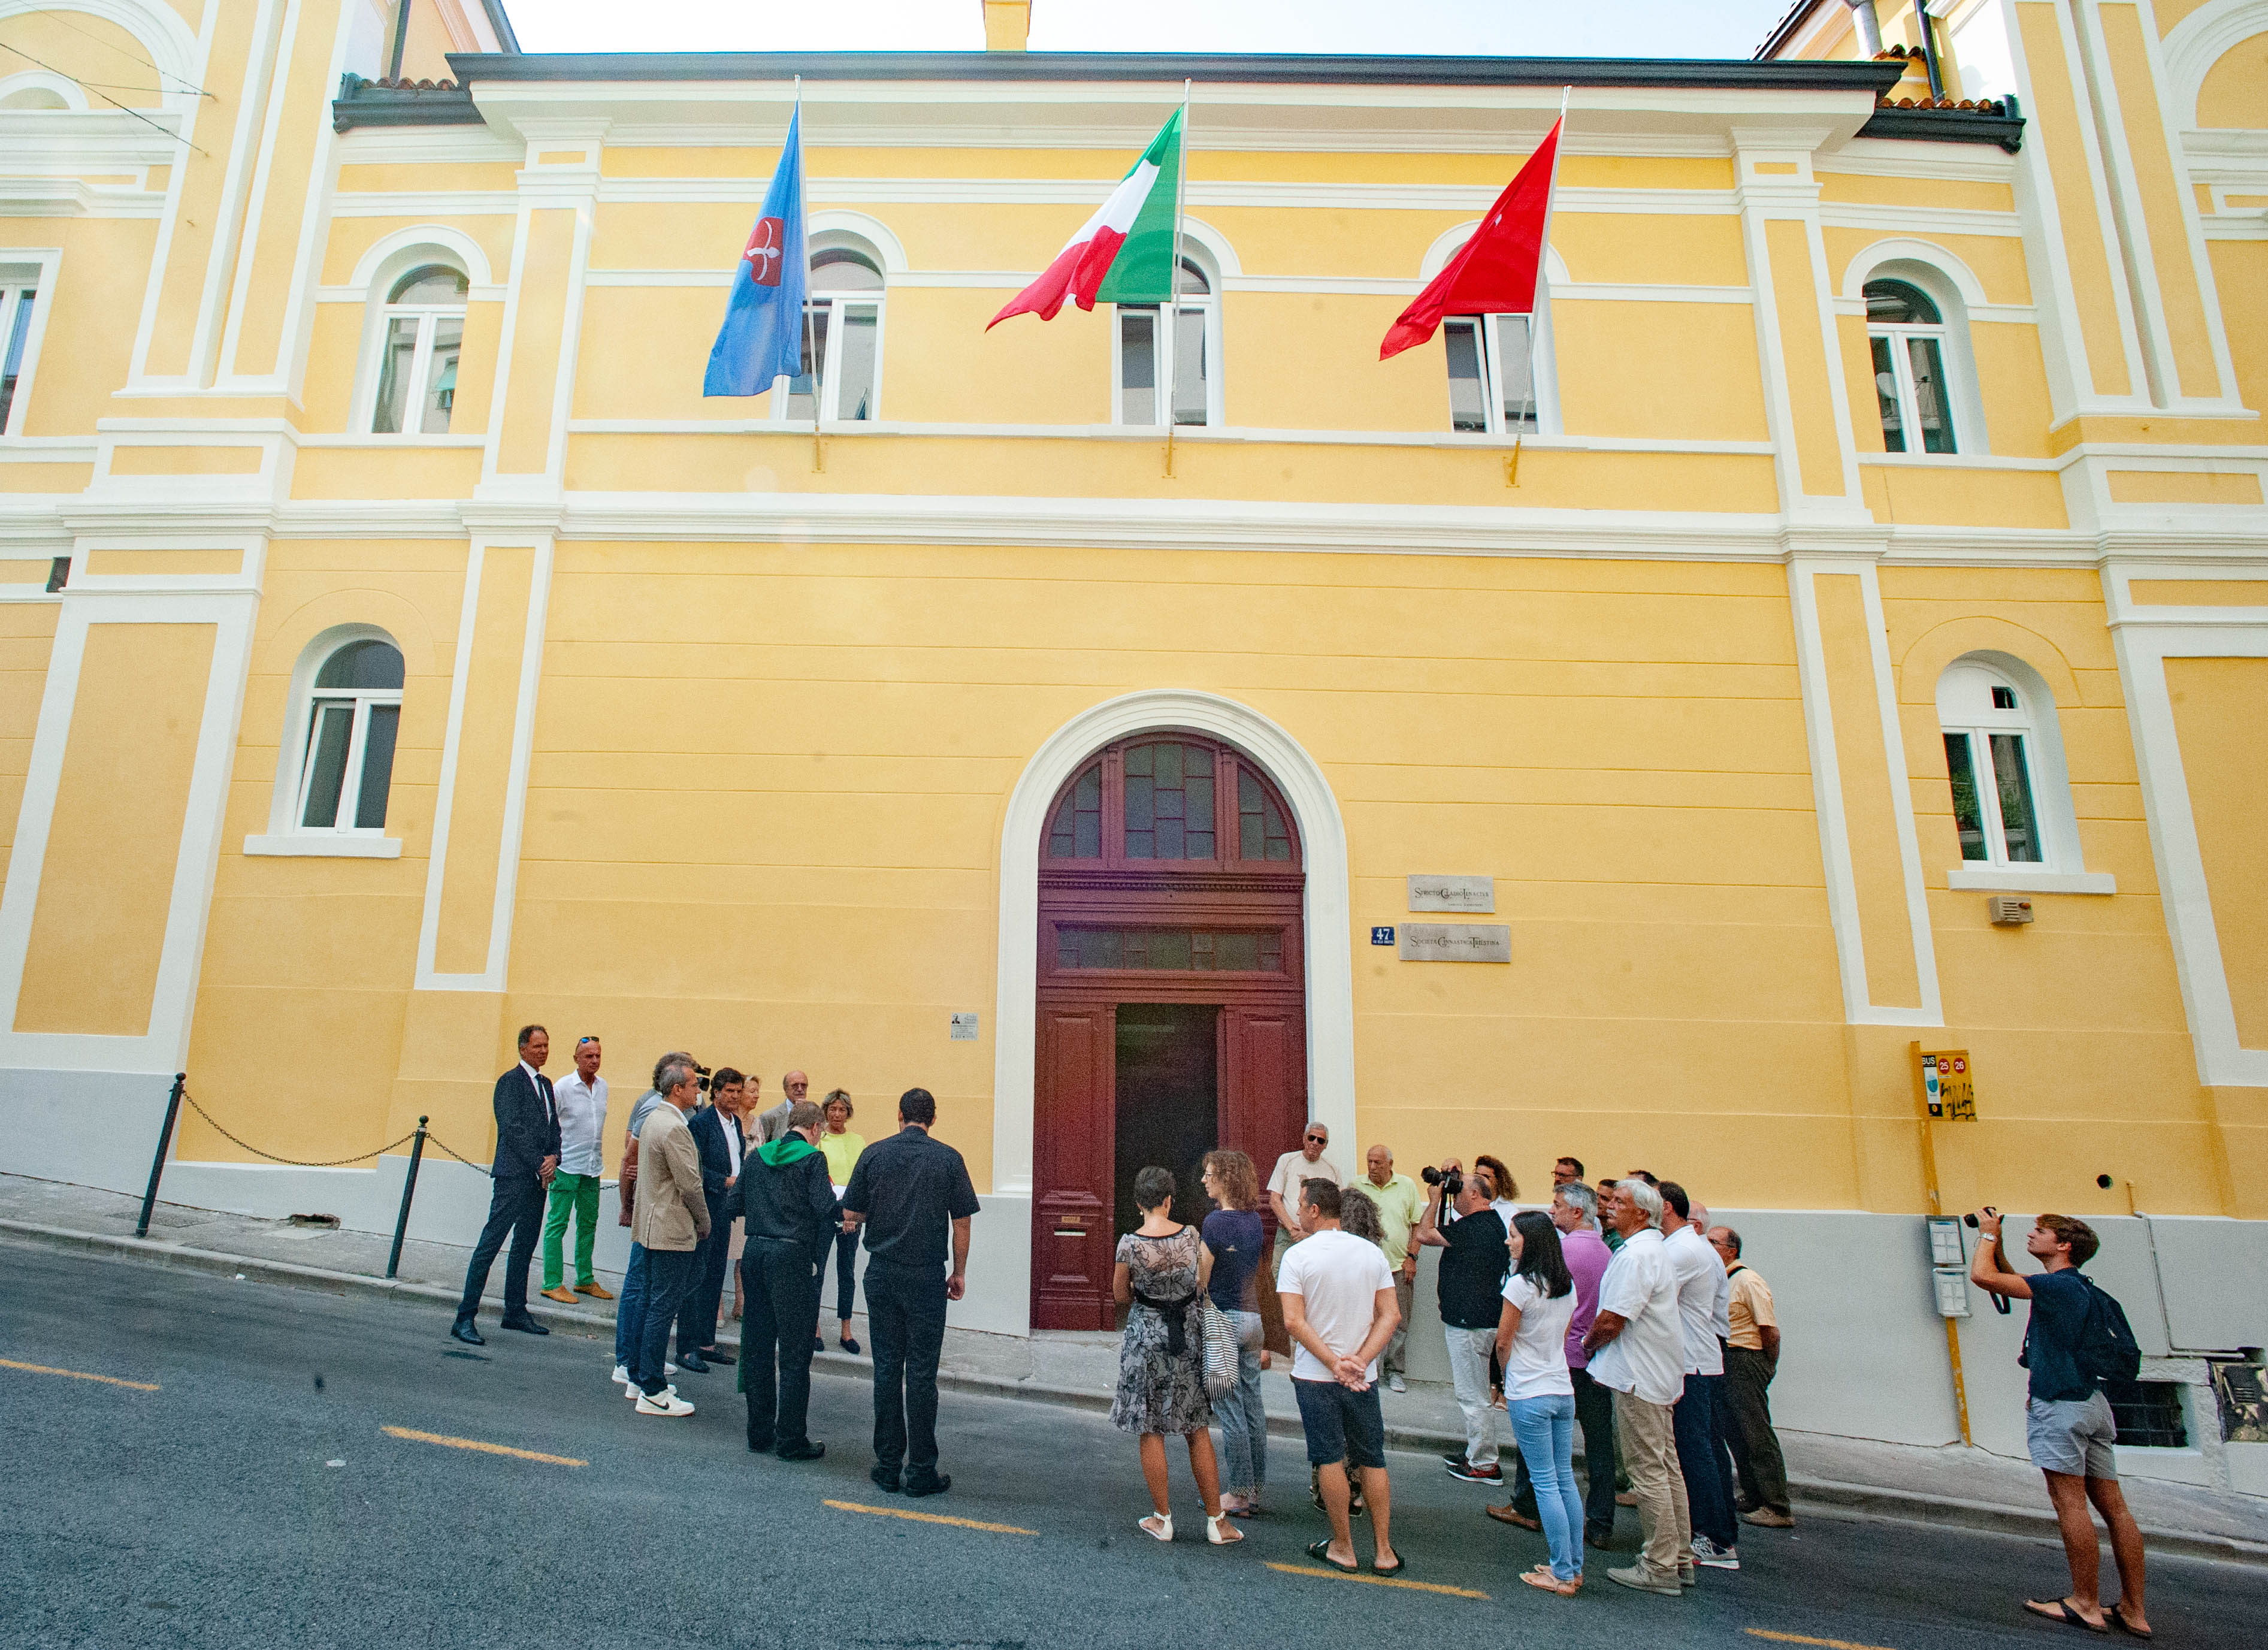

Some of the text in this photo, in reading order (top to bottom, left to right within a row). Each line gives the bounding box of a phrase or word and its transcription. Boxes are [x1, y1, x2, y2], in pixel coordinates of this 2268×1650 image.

[1414, 887, 1441, 898] STRICTO
[1377, 928, 1390, 940] 47
[1468, 936, 1500, 948] TRIESTINA
[1940, 1062, 1949, 1070] 25
[1955, 1061, 1964, 1069] 26
